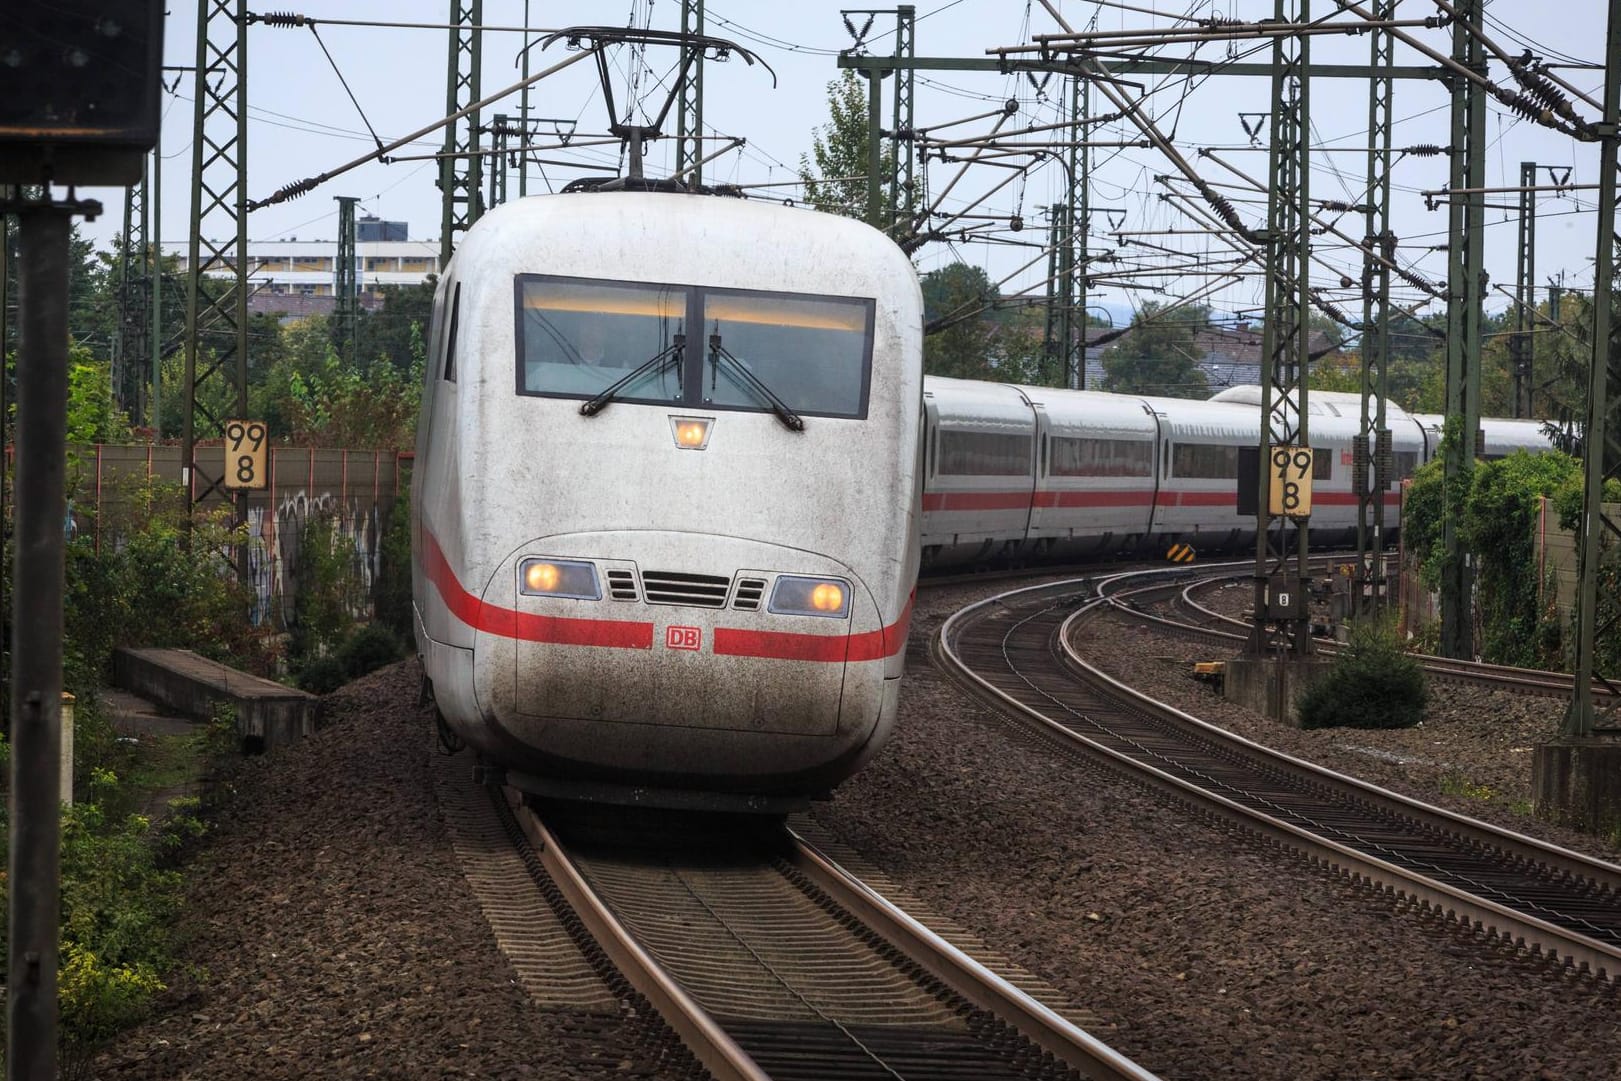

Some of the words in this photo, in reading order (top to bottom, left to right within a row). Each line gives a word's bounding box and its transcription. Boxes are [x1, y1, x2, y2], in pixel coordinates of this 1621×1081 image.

[227, 424, 265, 452] 99
[237, 455, 254, 483] 8
[1273, 450, 1311, 479] 99
[1284, 482, 1299, 509] 8
[670, 629, 698, 646] DB
